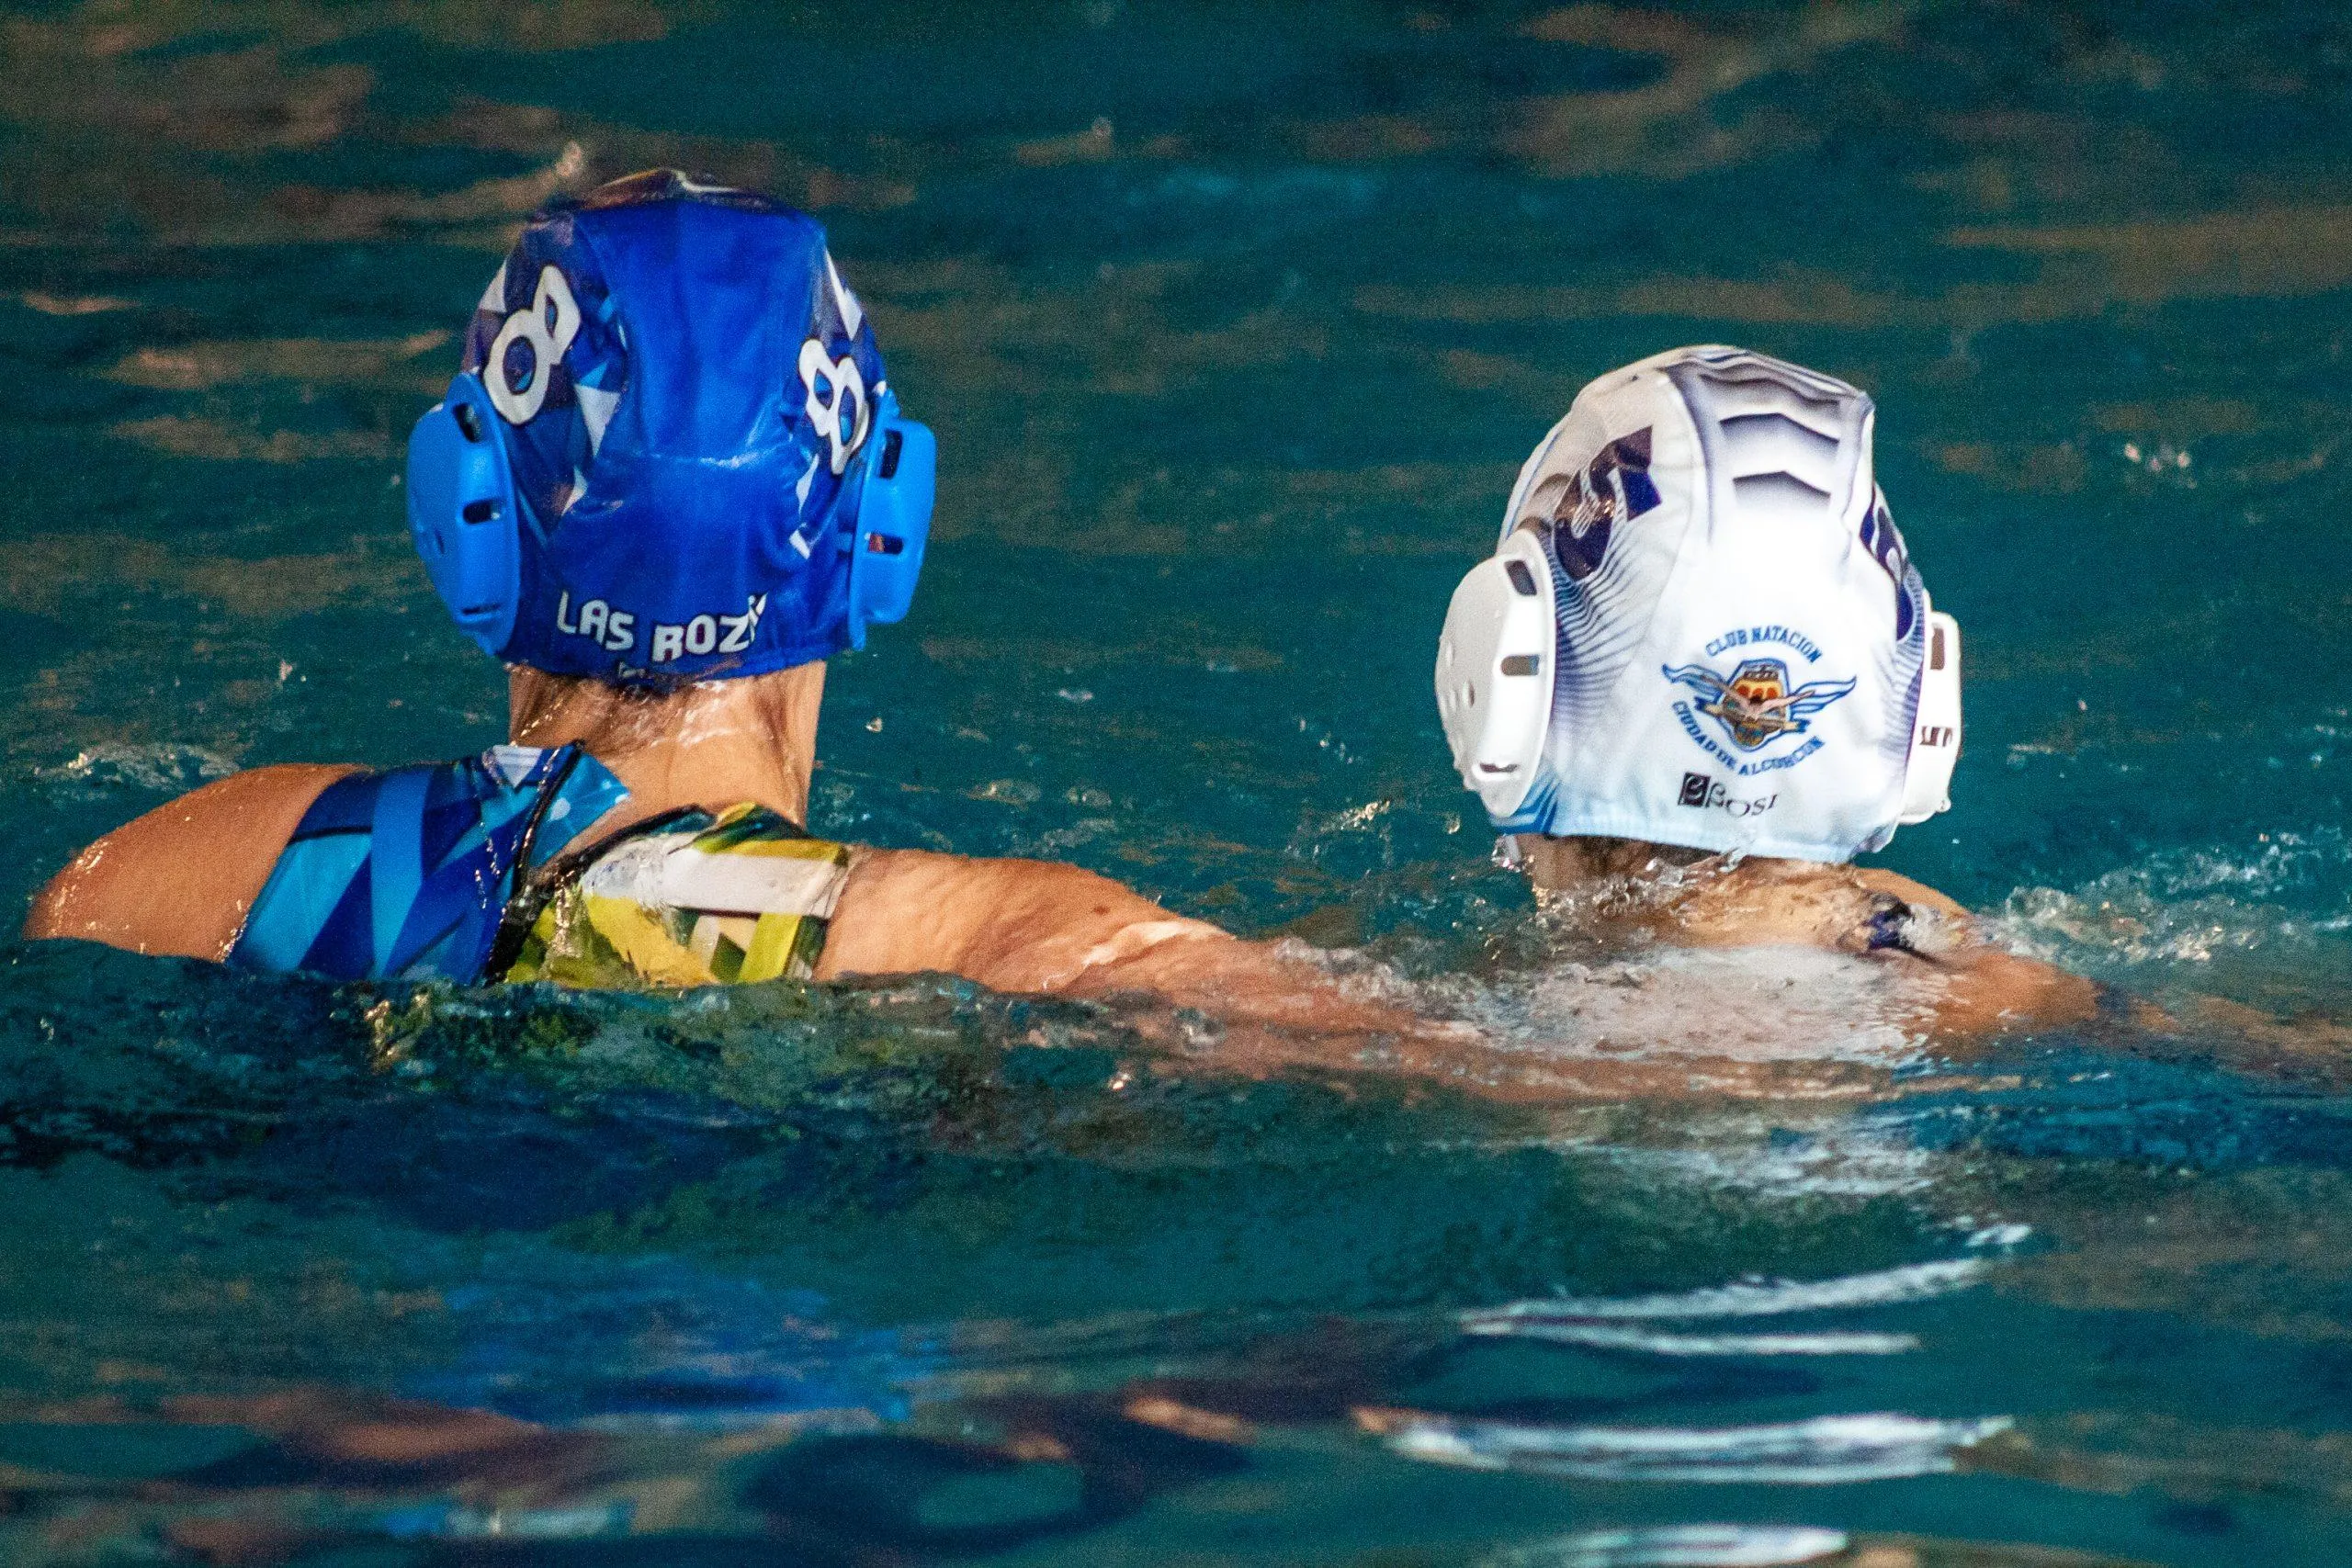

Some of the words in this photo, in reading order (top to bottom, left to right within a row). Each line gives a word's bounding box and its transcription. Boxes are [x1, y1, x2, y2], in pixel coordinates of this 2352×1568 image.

[483, 265, 581, 425] 8
[798, 339, 871, 475] 8
[557, 590, 634, 651] LAS
[1705, 629, 1747, 657] CLUB
